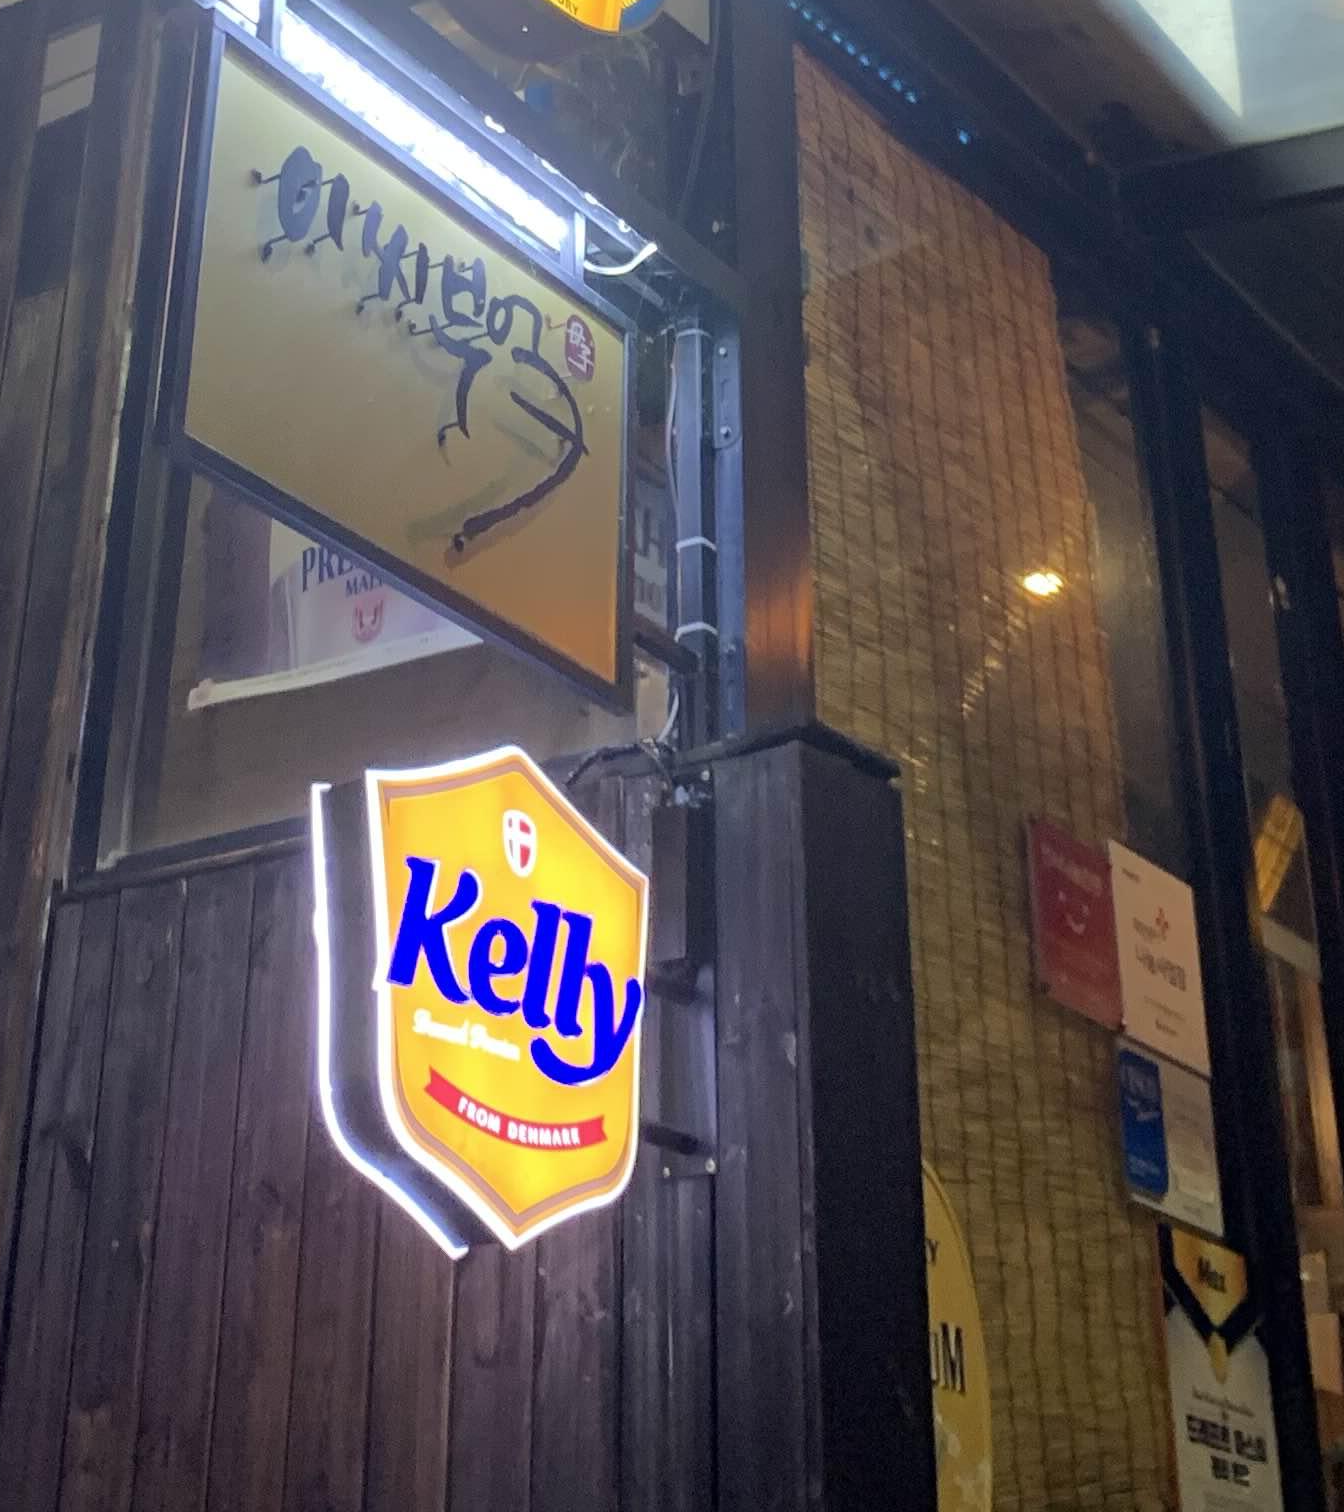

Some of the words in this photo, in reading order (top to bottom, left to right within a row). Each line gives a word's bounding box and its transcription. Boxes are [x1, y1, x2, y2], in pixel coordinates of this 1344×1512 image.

[277, 145, 590, 540] 이씨부엌
[387, 856, 643, 1086] Kelly
[457, 1096, 502, 1135] FROM
[507, 1120, 581, 1146] DENMARK
